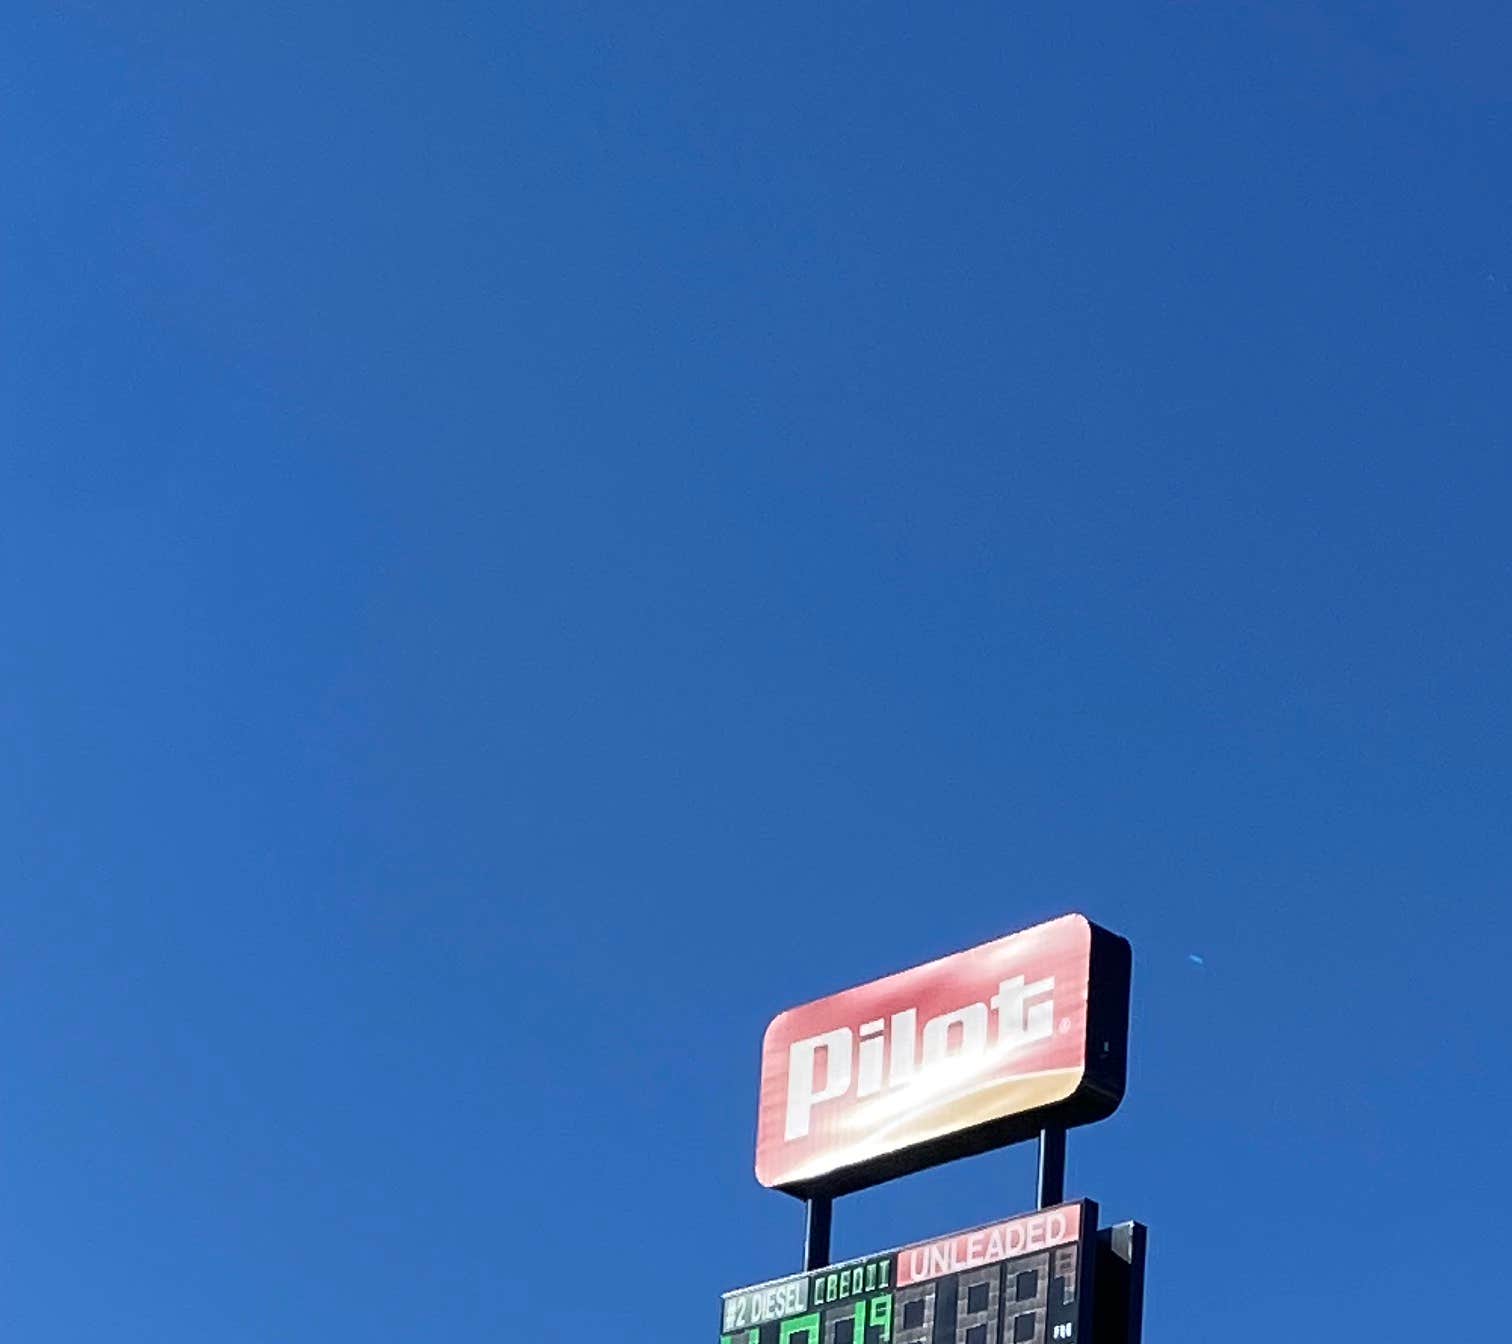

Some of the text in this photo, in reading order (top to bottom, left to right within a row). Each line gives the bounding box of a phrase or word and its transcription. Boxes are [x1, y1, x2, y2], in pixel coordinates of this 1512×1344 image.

[784, 974, 1055, 1142] Pilot
[910, 1212, 1067, 1282] UNLEADED
[751, 1285, 805, 1321] DIESEL
[814, 1260, 891, 1305] CREDIT
